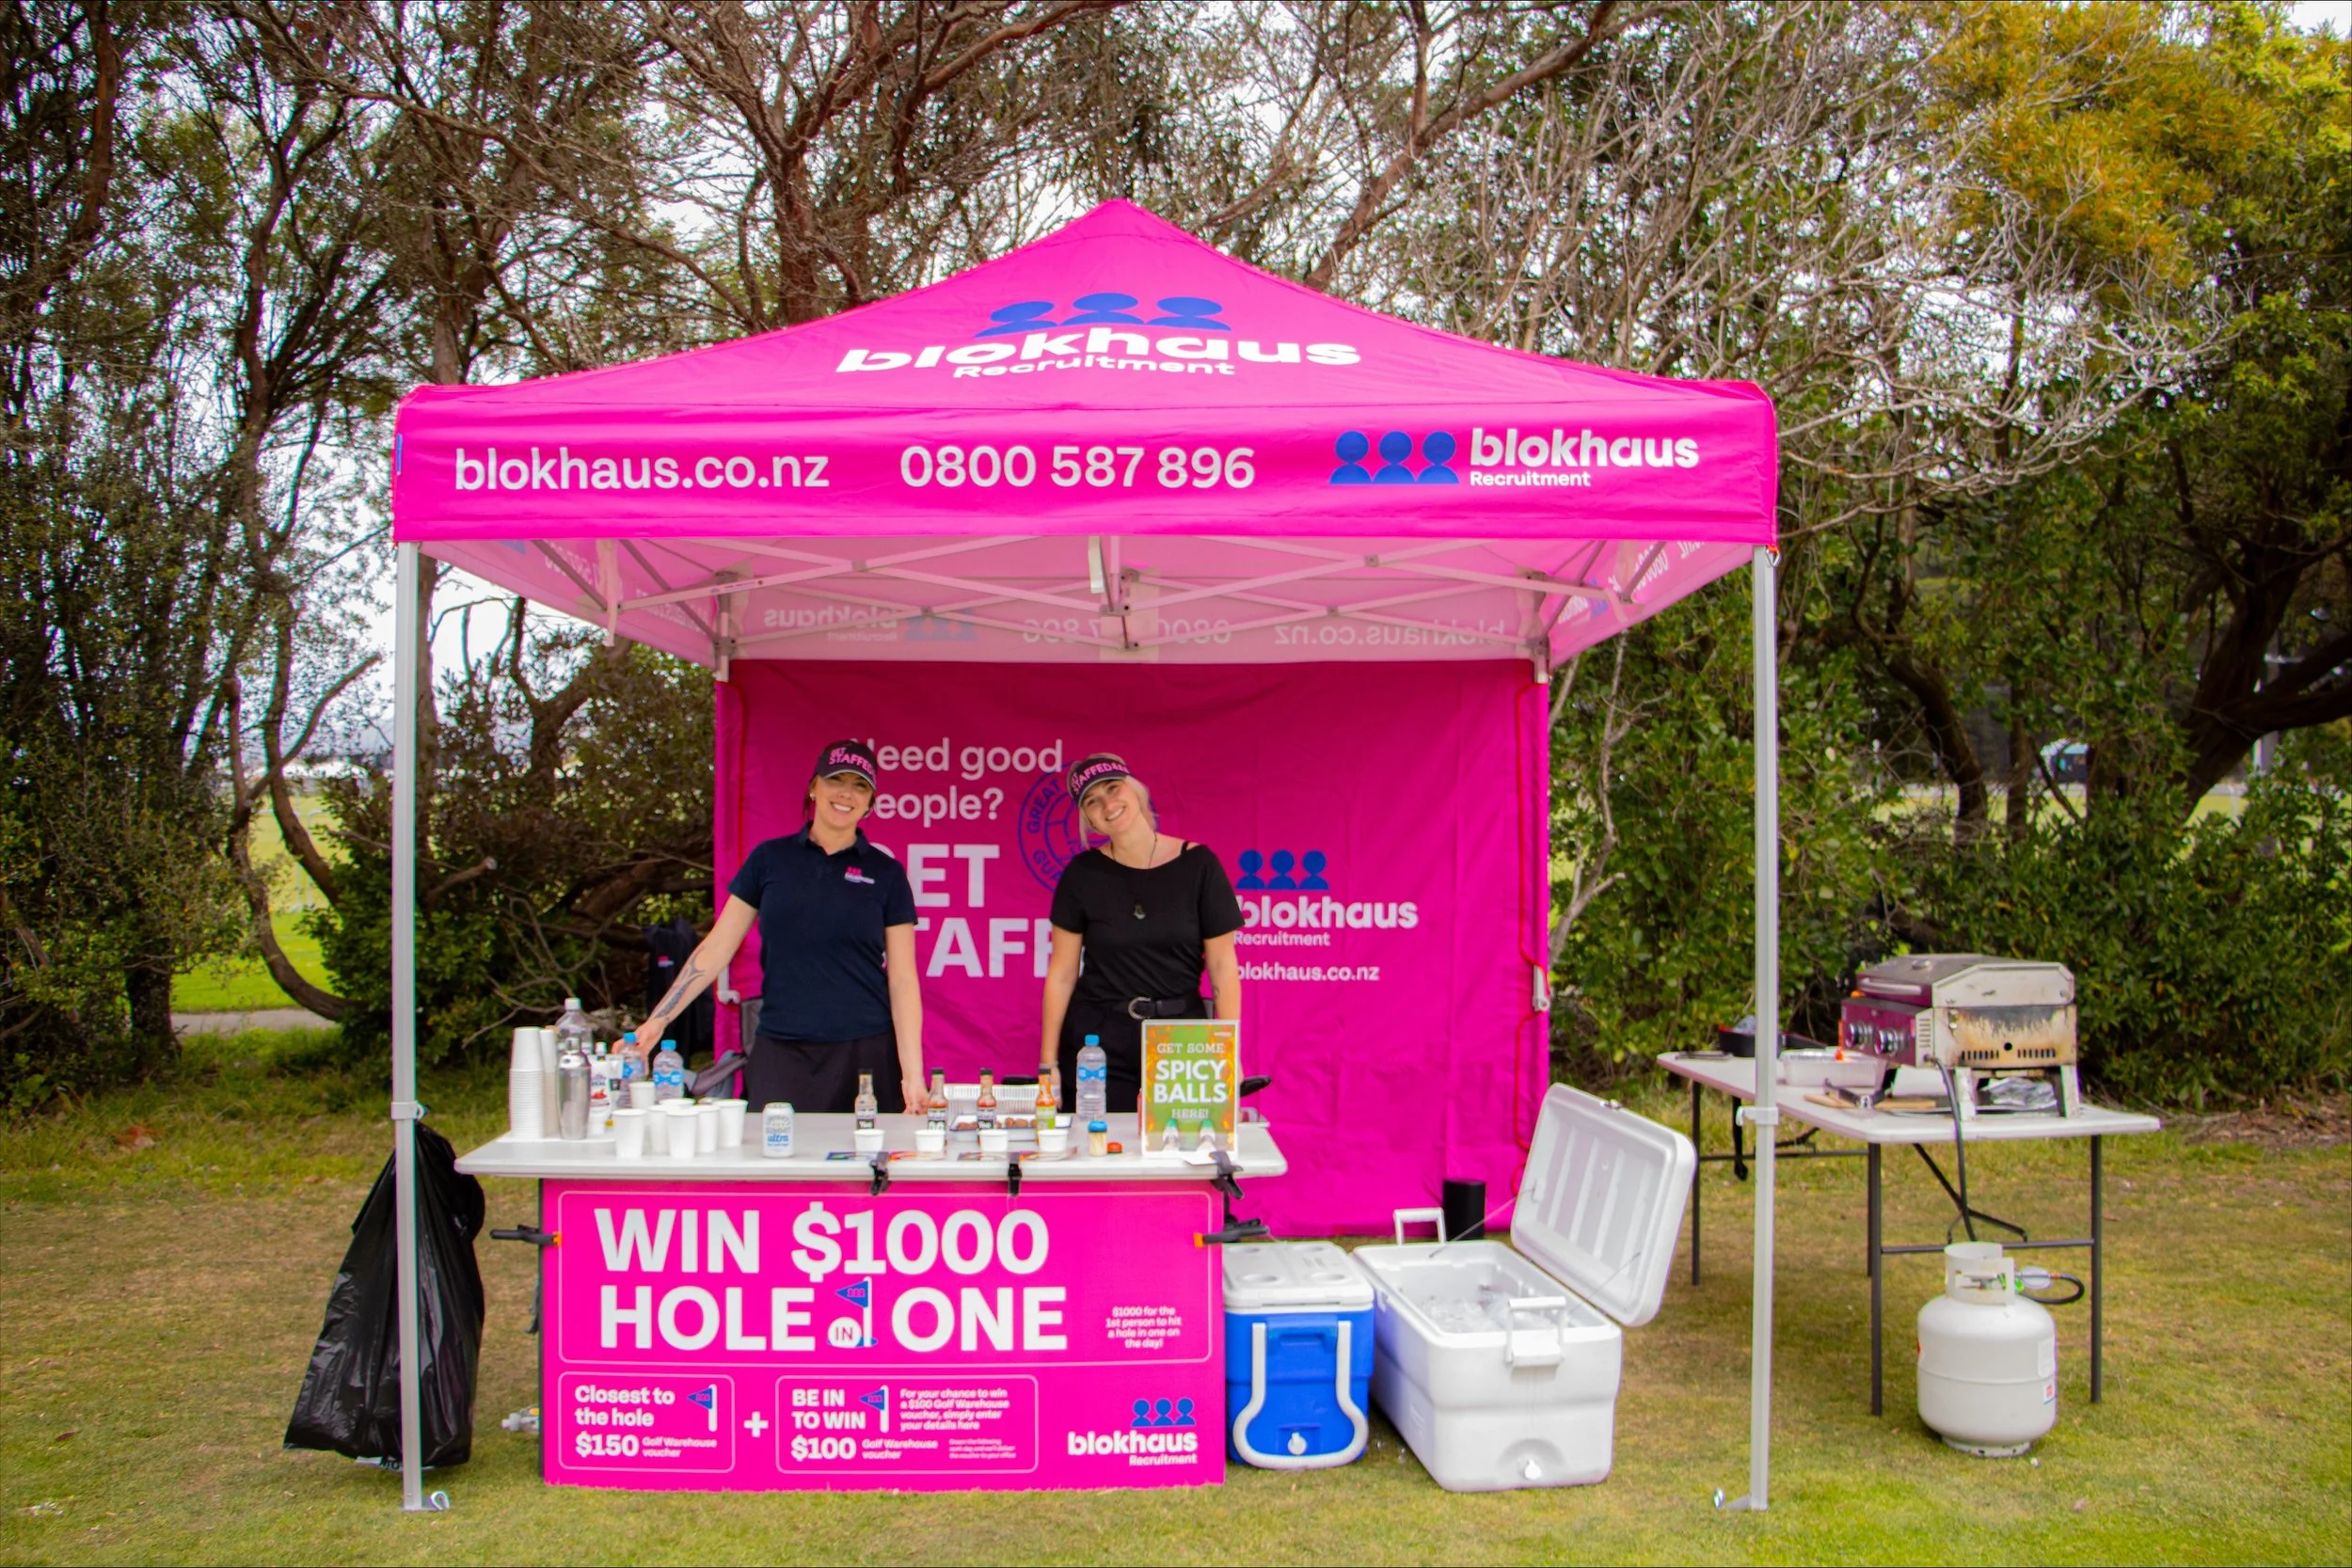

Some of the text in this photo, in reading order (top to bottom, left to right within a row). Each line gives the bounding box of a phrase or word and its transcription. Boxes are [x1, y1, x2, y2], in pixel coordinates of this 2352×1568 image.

[835, 326, 1361, 373] blokhaus
[953, 355, 1236, 378] Recruitment
[1470, 428, 1700, 467] blokhaus
[456, 447, 829, 490] blokhaus.co.nz
[901, 446, 1254, 488] 0800 587 896
[1470, 470, 1591, 486] Recruitment
[850, 736, 1062, 780] eed good
[865, 785, 1007, 829] eople?
[1026, 779, 1061, 834] GREAT
[869, 842, 1001, 909] ET
[1233, 930, 1331, 947] Recruitment
[1156, 1042, 1225, 1054] GET SOME
[1154, 1059, 1228, 1081] SPICY
[1153, 1082, 1228, 1103] BALLS
[595, 1201, 1049, 1283] WIN $1000
[600, 1285, 1067, 1352] HOLE IN ONE
[1112, 1306, 1175, 1317] $1000 for the
[1121, 1318, 1155, 1329] person
[1156, 1317, 1168, 1326] to
[1168, 1316, 1182, 1326] hit
[1116, 1328, 1136, 1338] hole
[1137, 1328, 1147, 1337] in
[1148, 1328, 1167, 1337] one
[1167, 1327, 1181, 1337] on
[1125, 1338, 1163, 1350] the day!
[575, 1385, 675, 1404] Closest to
[793, 1389, 844, 1406] BE IN
[900, 1387, 1009, 1401] For your chance to win
[908, 1398, 933, 1410] $100
[933, 1398, 954, 1409] Golf
[955, 1398, 1010, 1409] Warehouse
[574, 1406, 654, 1427] the hole
[792, 1412, 866, 1429] TO WIN
[943, 1409, 975, 1422] simply
[975, 1409, 1003, 1419] enter
[899, 1419, 980, 1433] your details here
[576, 1432, 639, 1457] $150
[642, 1436, 717, 1449] Golf Warehouse
[791, 1434, 856, 1461] $100
[861, 1438, 939, 1449] Golf Warehouse
[1066, 1428, 1199, 1457] blokhaus
[643, 1449, 681, 1457] voucher
[861, 1449, 902, 1460] voucher
[1129, 1454, 1199, 1466] Recruitment
